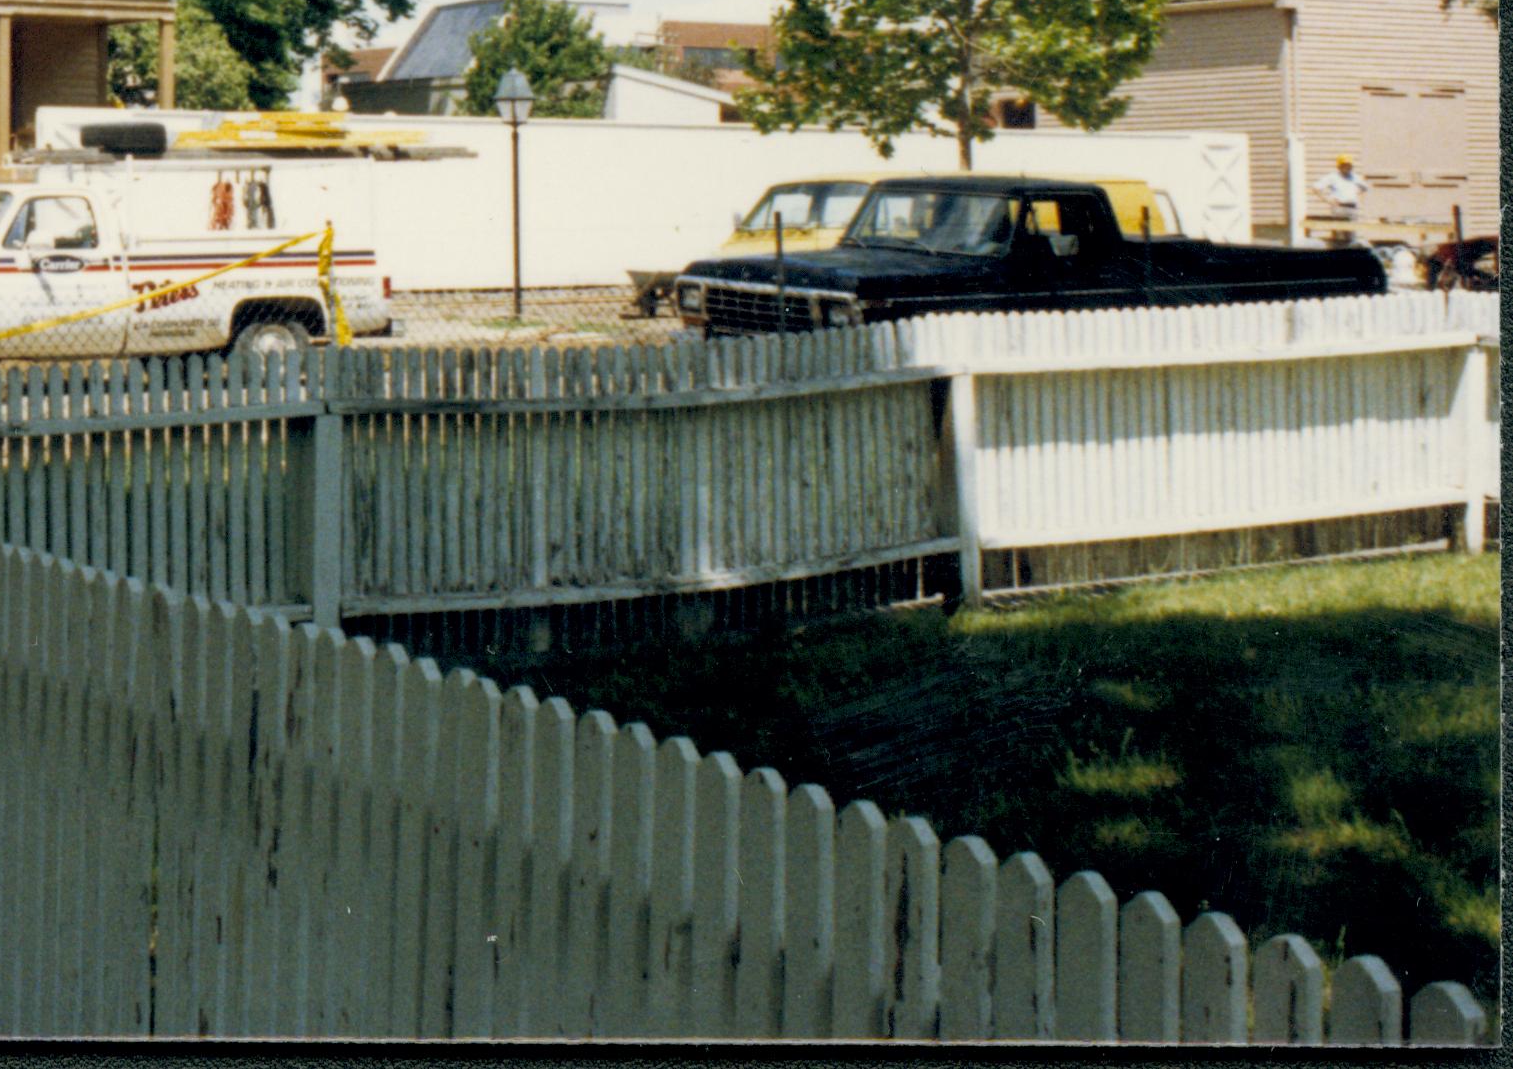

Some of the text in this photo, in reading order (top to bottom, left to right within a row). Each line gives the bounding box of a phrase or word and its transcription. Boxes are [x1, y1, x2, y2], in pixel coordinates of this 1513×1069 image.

[40, 258, 81, 272] Carrier
[214, 279, 260, 289] HEATING
[276, 278, 294, 288] AIR
